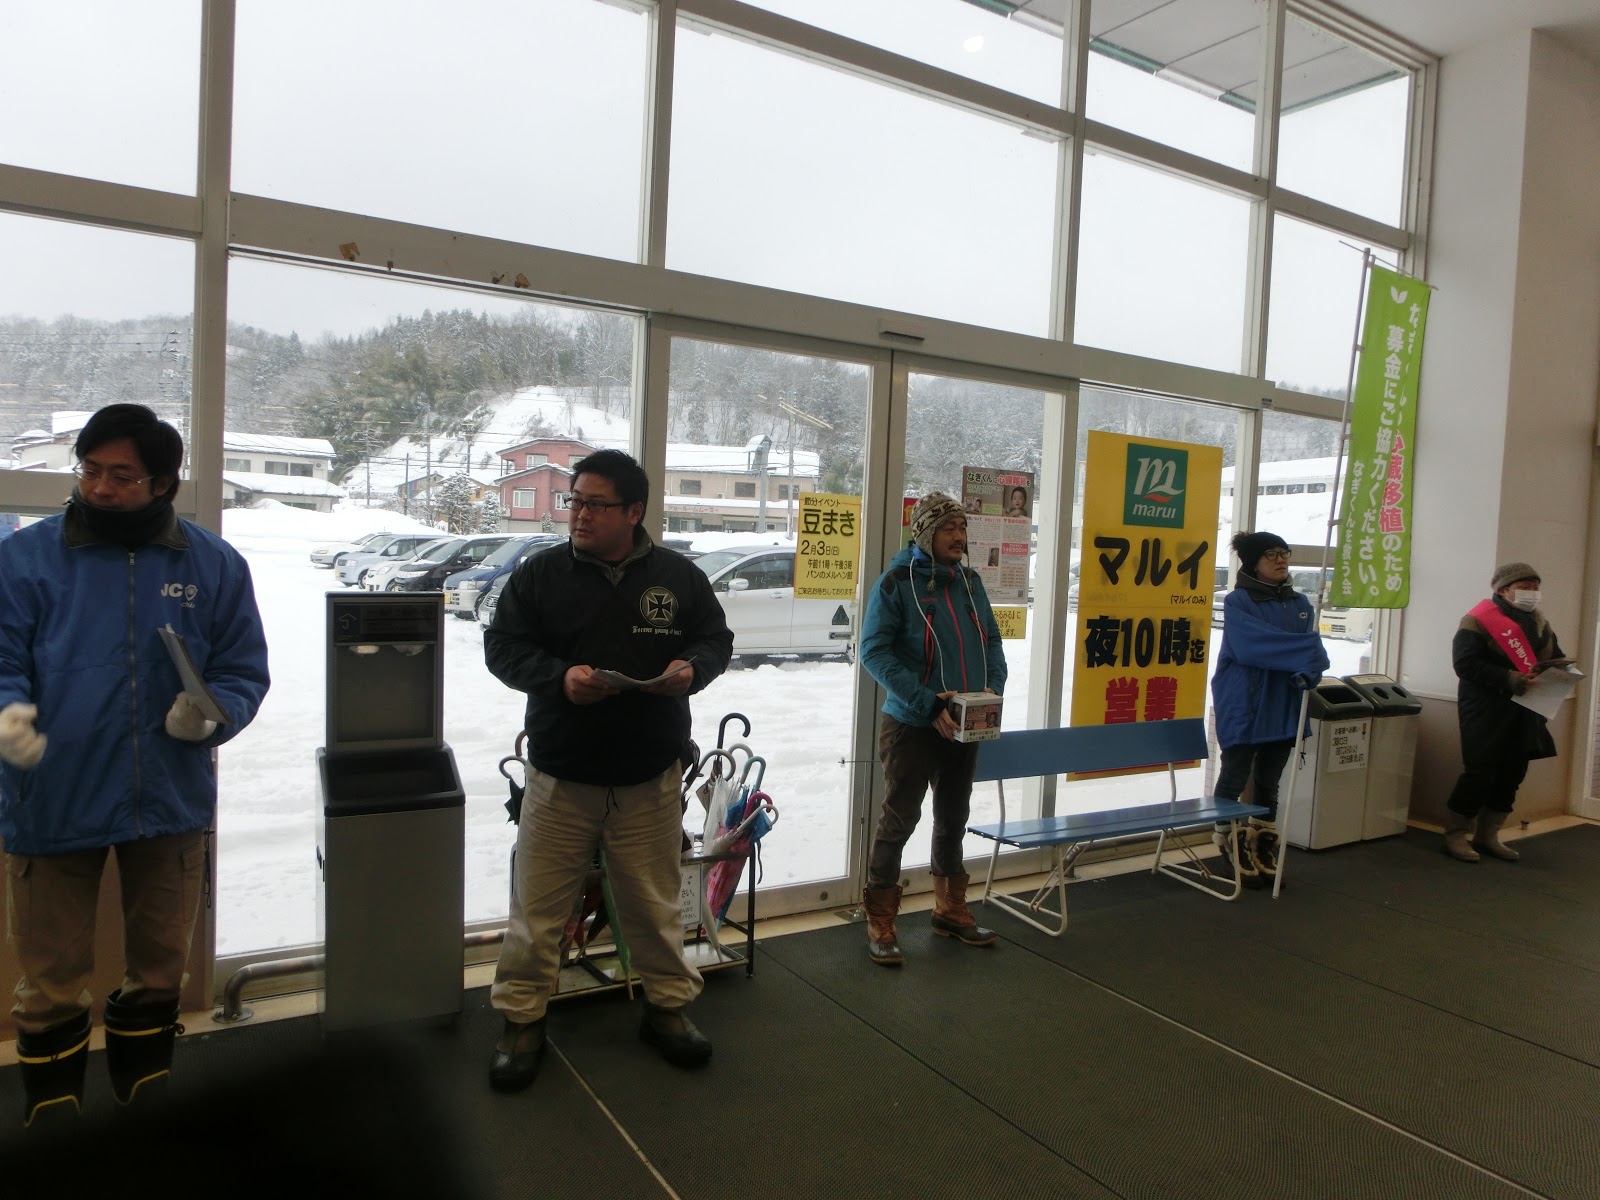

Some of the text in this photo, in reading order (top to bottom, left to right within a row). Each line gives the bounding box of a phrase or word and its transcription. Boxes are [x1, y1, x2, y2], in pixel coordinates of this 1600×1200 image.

[1358, 325, 1404, 596] 募金にご協力ください。
[804, 496, 841, 507] 節分イベント
[1133, 503, 1177, 519] marui
[801, 508, 855, 537] 豆まき
[1094, 536, 1209, 590] マルイ
[1085, 615, 1206, 668] 夜10時迄
[1508, 638, 1532, 670] なぎく
[1104, 676, 1178, 724] 営業
